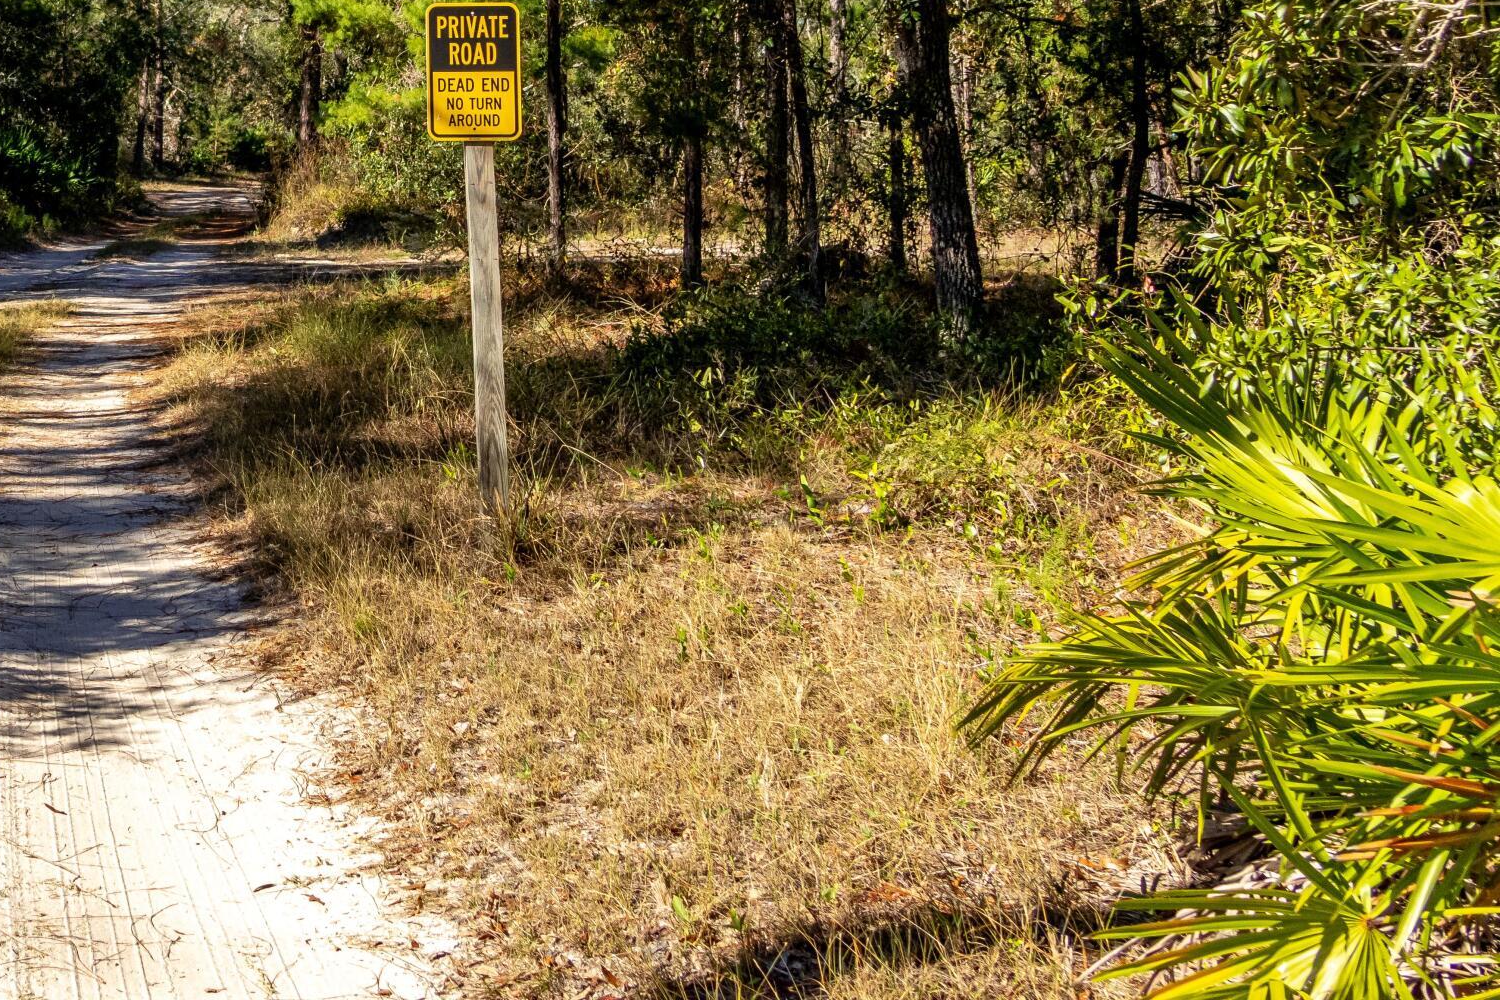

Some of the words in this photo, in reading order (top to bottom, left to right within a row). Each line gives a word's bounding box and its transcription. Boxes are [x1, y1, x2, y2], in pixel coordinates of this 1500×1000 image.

[436, 15, 509, 39] PRIVATE
[449, 42, 497, 66] ROAD
[437, 77, 475, 93] DEAD
[481, 77, 510, 92] END
[446, 97, 464, 110] NO
[469, 97, 502, 110] TURN
[448, 113, 500, 127] AROUND
